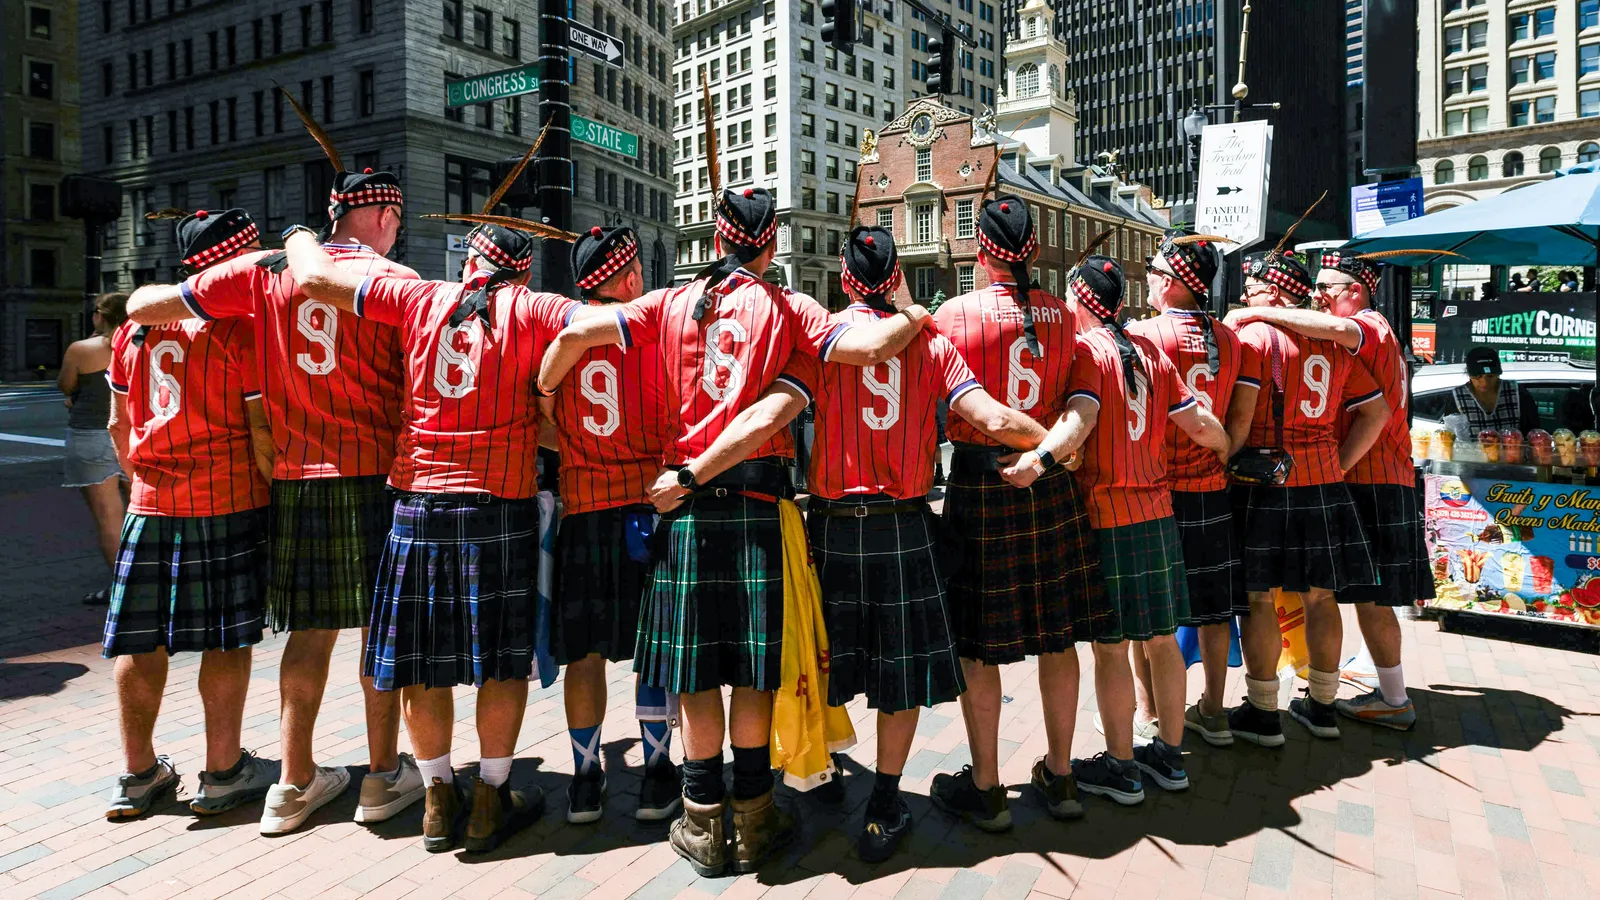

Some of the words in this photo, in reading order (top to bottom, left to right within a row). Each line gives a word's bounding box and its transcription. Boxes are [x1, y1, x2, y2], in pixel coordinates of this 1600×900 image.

[572, 30, 588, 46] ONE
[591, 37, 607, 53] WAY
[464, 71, 526, 101] CONGRESS
[586, 122, 622, 151] STATE
[627, 143, 635, 154] ST
[1219, 135, 1244, 149] The
[1206, 147, 1257, 162] Freedom
[1215, 162, 1248, 176] Trail
[1205, 205, 1250, 214] FANEUIL
[1213, 215, 1242, 223] HALL
[297, 298, 338, 375] 9
[1471, 310, 1596, 337] #ONEVERYCORNE
[1471, 335, 1486, 343] THIS
[1486, 336, 1528, 345] TOURNAMENT,
[1529, 337, 1542, 345] YOU
[1543, 338, 1564, 346] COULD
[1565, 338, 1580, 346] WIN
[433, 320, 479, 399] 6
[702, 318, 746, 400] 6
[1006, 336, 1044, 411] 6
[149, 340, 184, 418] 6
[862, 354, 901, 430] 9
[1300, 354, 1331, 418] 9
[580, 359, 620, 437] 9
[1124, 369, 1148, 441] 9
[1487, 483, 1535, 505] Fruits
[1536, 494, 1552, 511] y
[1495, 508, 1543, 528] Queens
